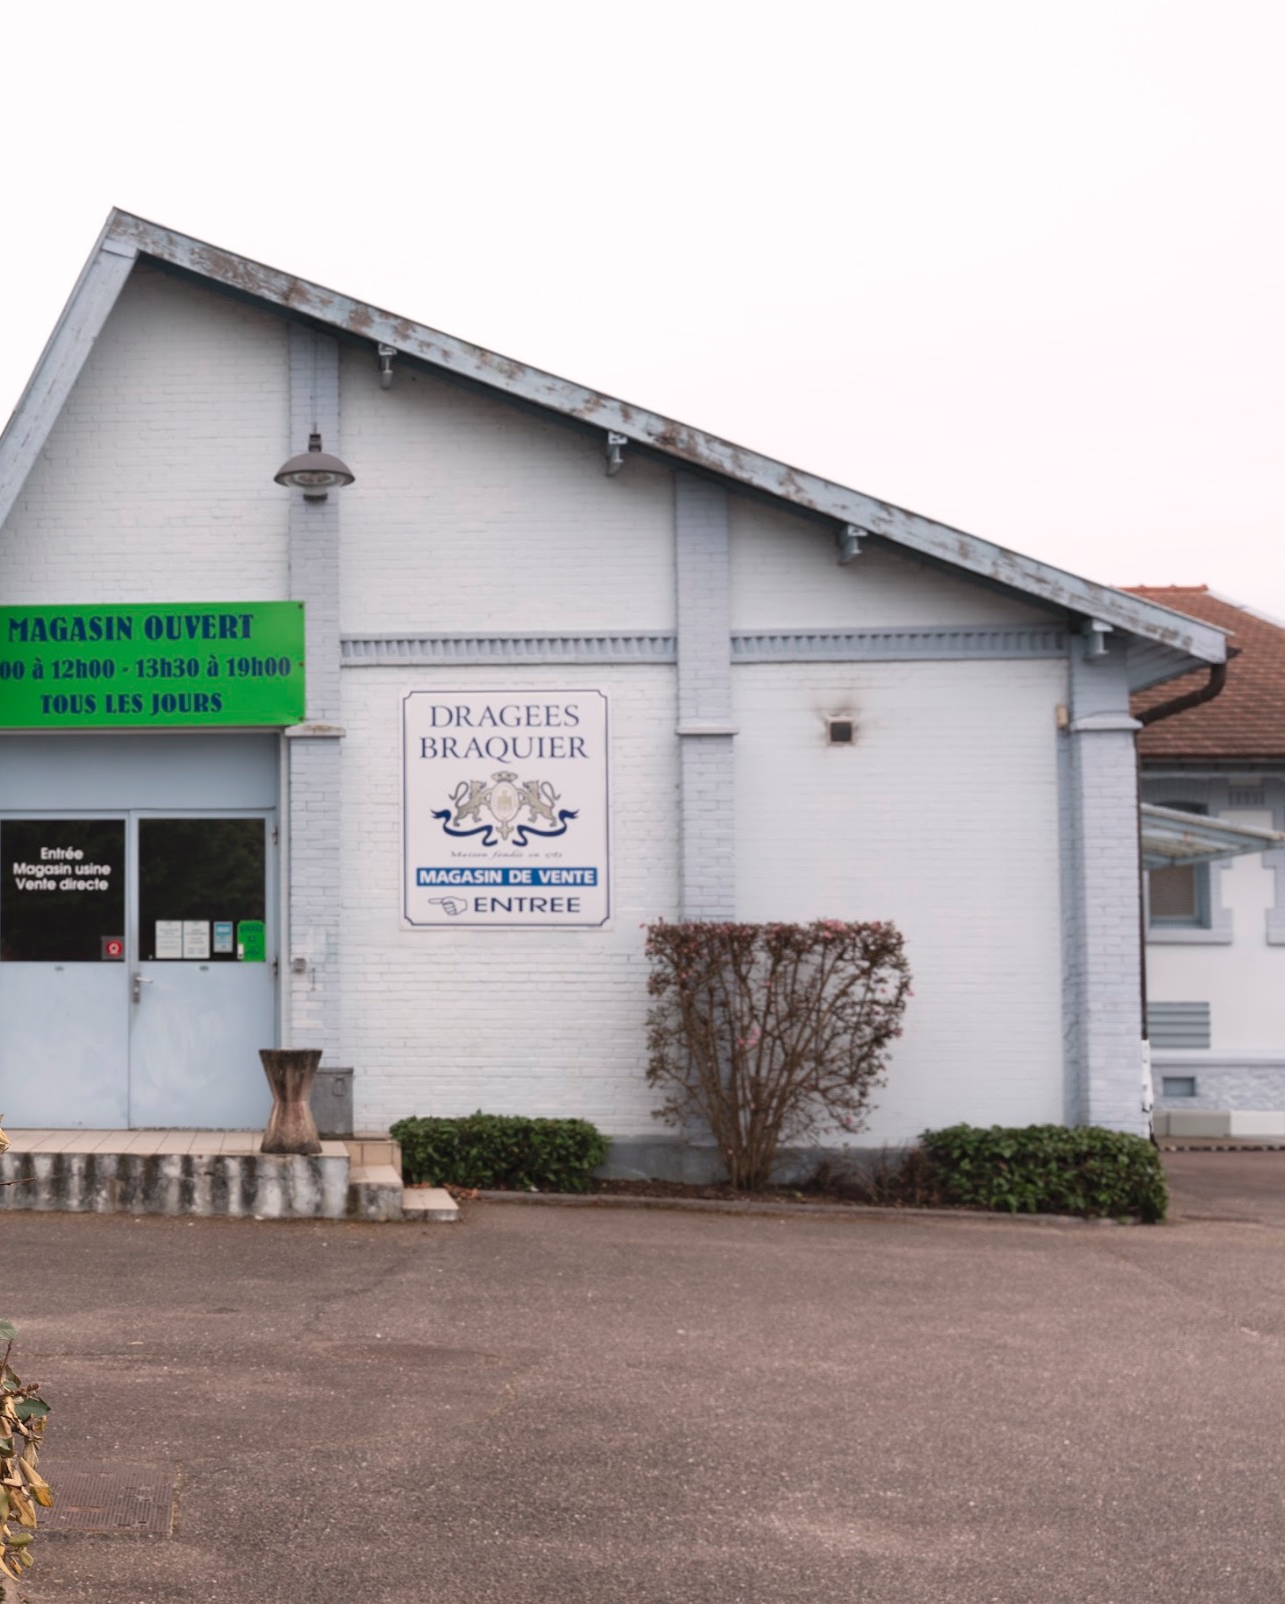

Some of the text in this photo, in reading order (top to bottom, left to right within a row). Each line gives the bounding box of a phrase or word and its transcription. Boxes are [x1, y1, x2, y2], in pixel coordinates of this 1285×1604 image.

[8, 614, 254, 642] MAGASIN OUVERT
[32, 658, 44, 680] à
[51, 659, 115, 680] 12h00
[136, 657, 200, 679] 13h30
[207, 656, 219, 678] à
[225, 657, 291, 678] 19h00
[41, 692, 223, 716] TOUS LES JOURS
[429, 704, 580, 728] DRAGEES
[419, 736, 589, 763] BRAQUIER
[40, 846, 83, 860] Entrée
[13, 862, 111, 877] Magasin usine
[419, 869, 595, 884] MAGASIN DE VENTE
[15, 877, 109, 891] Vente directe
[474, 896, 581, 913] ENTREE
